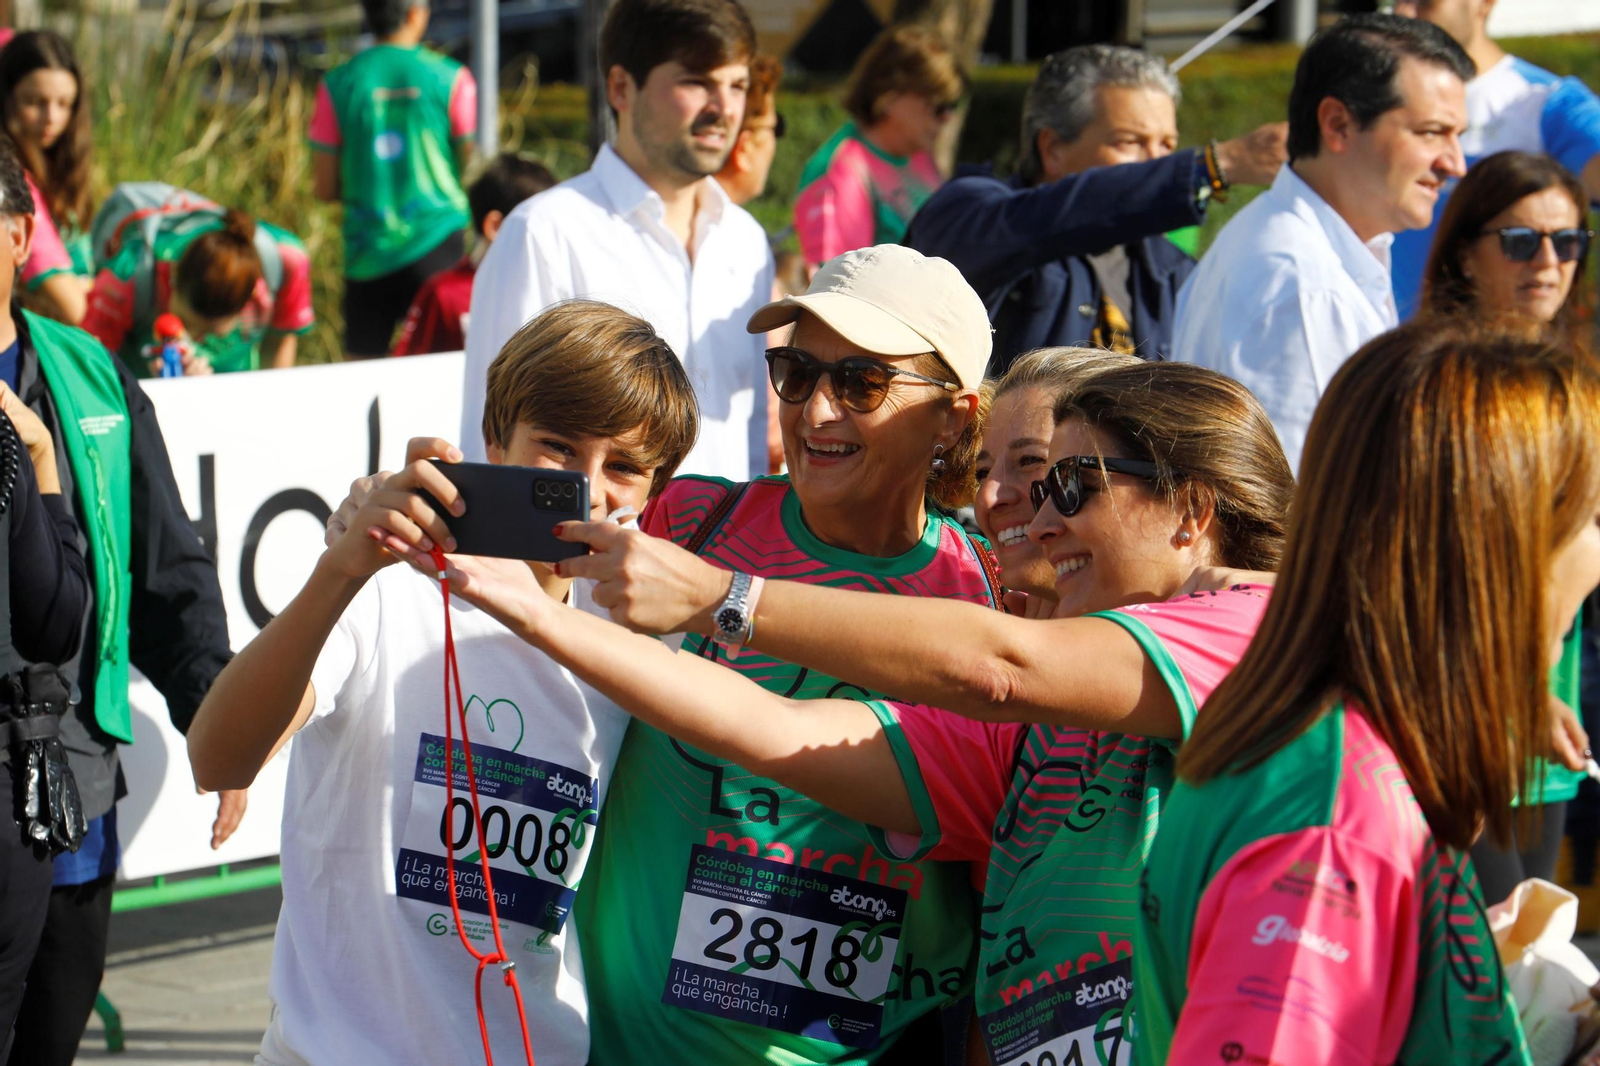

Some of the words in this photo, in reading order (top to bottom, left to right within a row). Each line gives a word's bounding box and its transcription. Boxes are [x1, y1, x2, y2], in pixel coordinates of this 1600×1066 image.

[426, 742, 483, 765] Códoa
[486, 757, 502, 768] en
[504, 762, 546, 780] marcha
[433, 769, 455, 778] MARCA
[472, 765, 482, 776] el
[485, 769, 526, 786] cáncer
[427, 775, 448, 784] CARRER
[710, 766, 780, 826] La
[440, 797, 571, 875] 0008
[401, 872, 431, 888] que
[412, 858, 431, 875] La
[696, 854, 754, 876] Córdoba
[756, 869, 775, 881] en
[777, 871, 829, 893] marcha
[705, 828, 924, 901] marcha
[694, 867, 736, 884] contra
[739, 876, 753, 888] el
[755, 880, 804, 898] cáncer
[696, 886, 718, 895] CARRERA
[718, 890, 739, 899] CONTRA
[745, 896, 768, 905] CÁNCER
[702, 879, 723, 889] MARCHA
[722, 884, 743, 895] CONTRA
[750, 890, 772, 900] CÁNCER
[703, 908, 862, 988] 2818
[985, 925, 1036, 978] La
[672, 983, 700, 998] que
[703, 989, 779, 1017] engancha
[682, 969, 699, 986] La
[703, 977, 760, 998] marcha
[987, 1011, 1025, 1035] Córdoba
[1024, 1006, 1034, 1018] en
[1035, 989, 1072, 1012] marcha
[991, 1027, 1020, 1047] contra
[1020, 1022, 1027, 1034] el
[1026, 1009, 1054, 1029] cáncer
